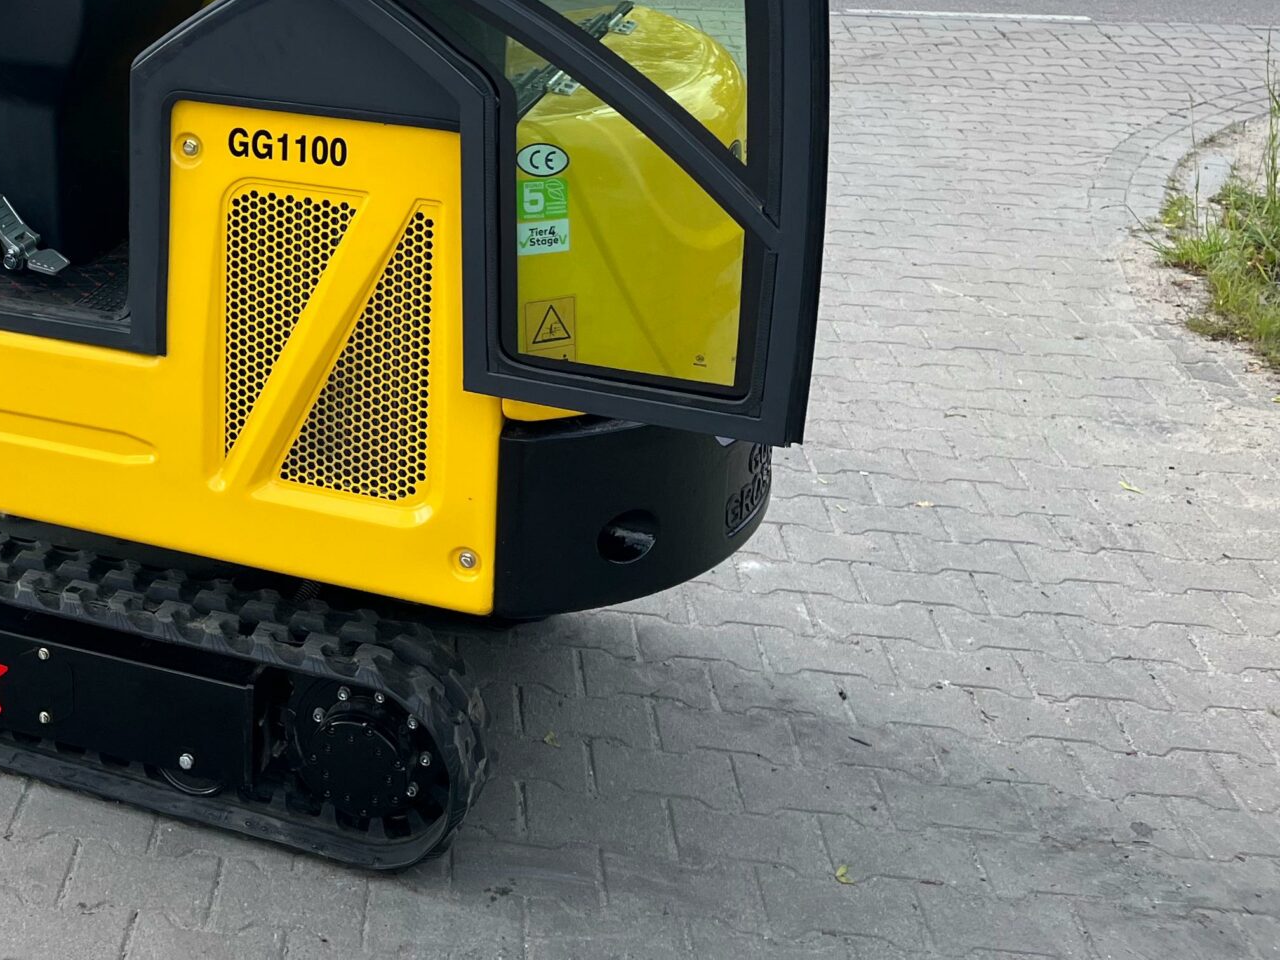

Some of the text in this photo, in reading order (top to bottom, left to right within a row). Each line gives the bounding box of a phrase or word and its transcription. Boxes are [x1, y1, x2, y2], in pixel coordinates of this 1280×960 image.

[228, 127, 347, 167] GG1100
[529, 150, 556, 170] CE
[529, 236, 559, 247] Stage
